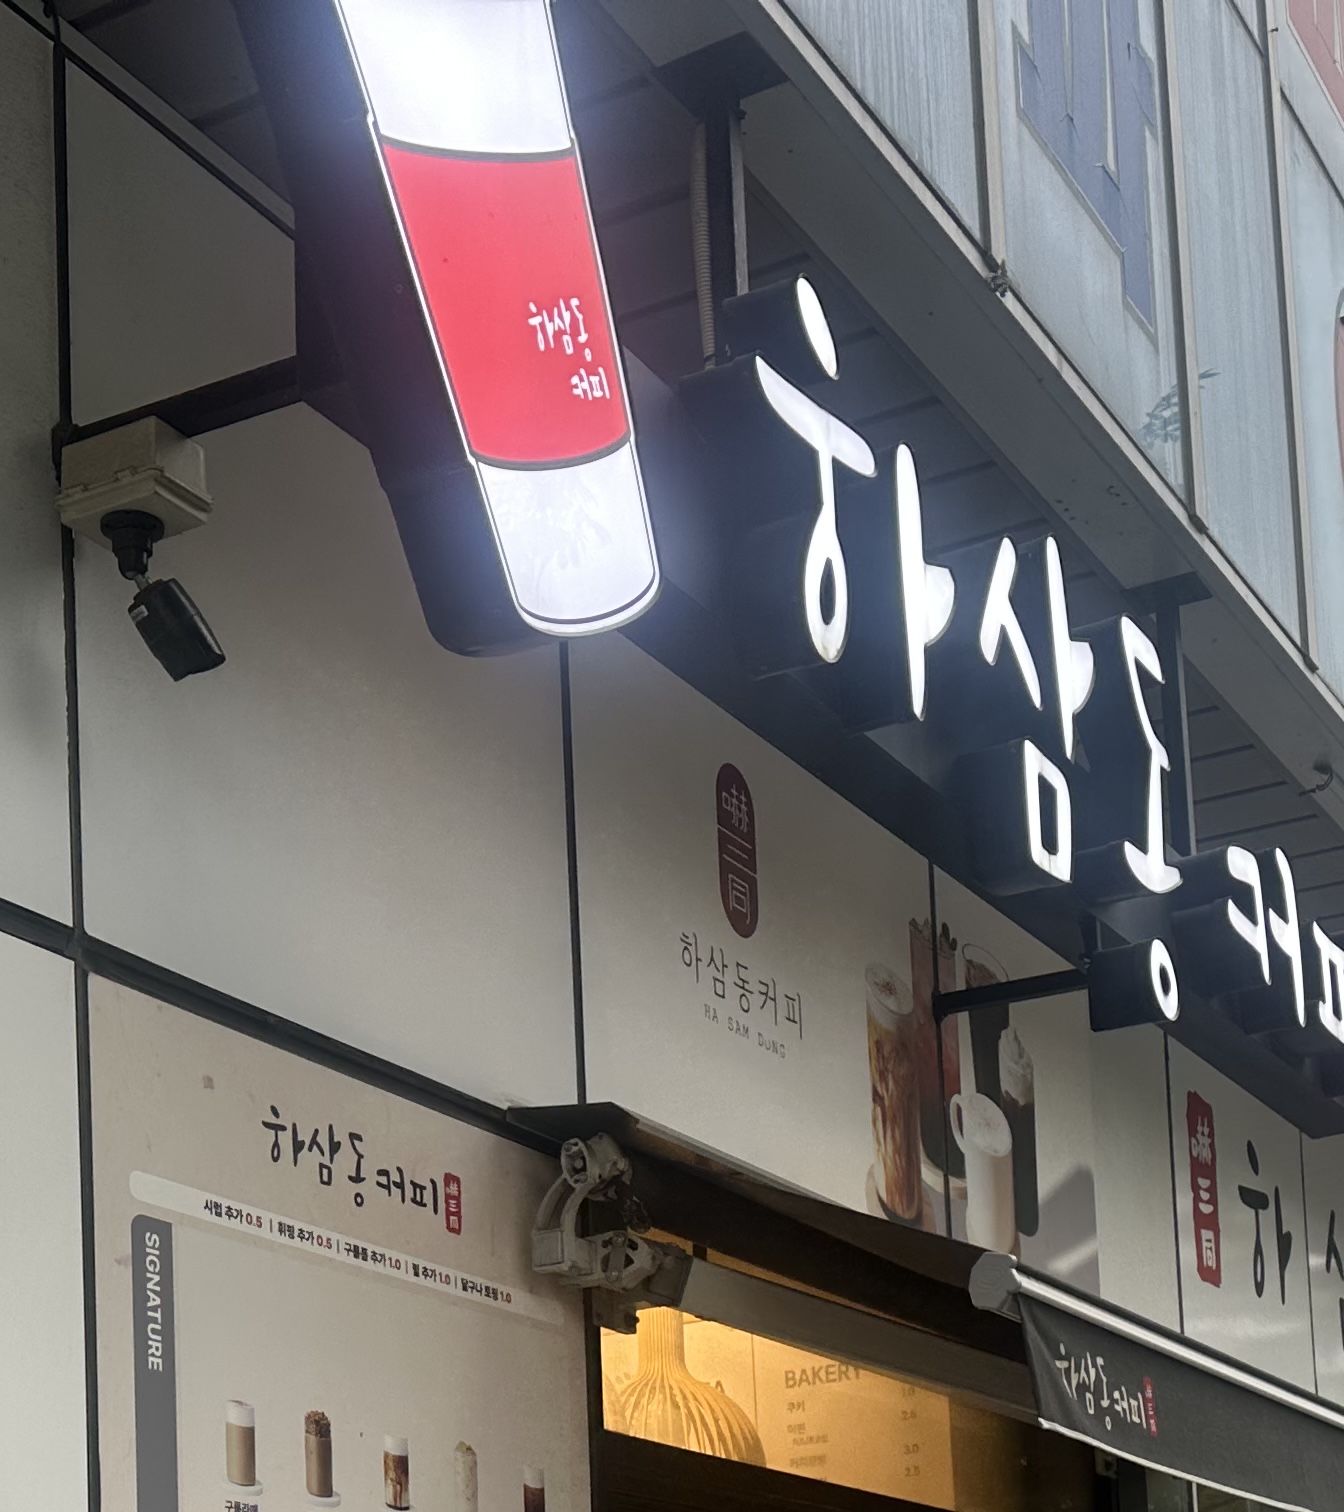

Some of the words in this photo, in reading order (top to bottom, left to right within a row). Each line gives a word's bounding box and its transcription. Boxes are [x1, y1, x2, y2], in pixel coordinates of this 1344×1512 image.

[528, 297, 592, 362] 하삼동
[571, 367, 611, 400] 커피
[679, 931, 804, 1040] 하삼동커피
[703, 1003, 719, 1025] HA
[727, 1016, 750, 1041] SAM
[261, 1105, 440, 1216] 하삼동커피
[203, 1198, 223, 1217] 시럽
[224, 1205, 243, 1224] 추가
[245, 1212, 263, 1228] 0.5
[277, 1220, 295, 1240] 휘핑
[297, 1227, 315, 1246] 추가
[316, 1234, 333, 1250] 0.5
[370, 1249, 387, 1266] 추가
[388, 1256, 402, 1271] 1.0
[421, 1266, 437, 1282] 추가
[438, 1272, 451, 1286] 1.0
[499, 1290, 512, 1304] 1.0
[143, 1232, 164, 1373] SIGNATURE
[784, 1363, 861, 1389] BAKERY
[1055, 1342, 1147, 1431] 하삼동커피
